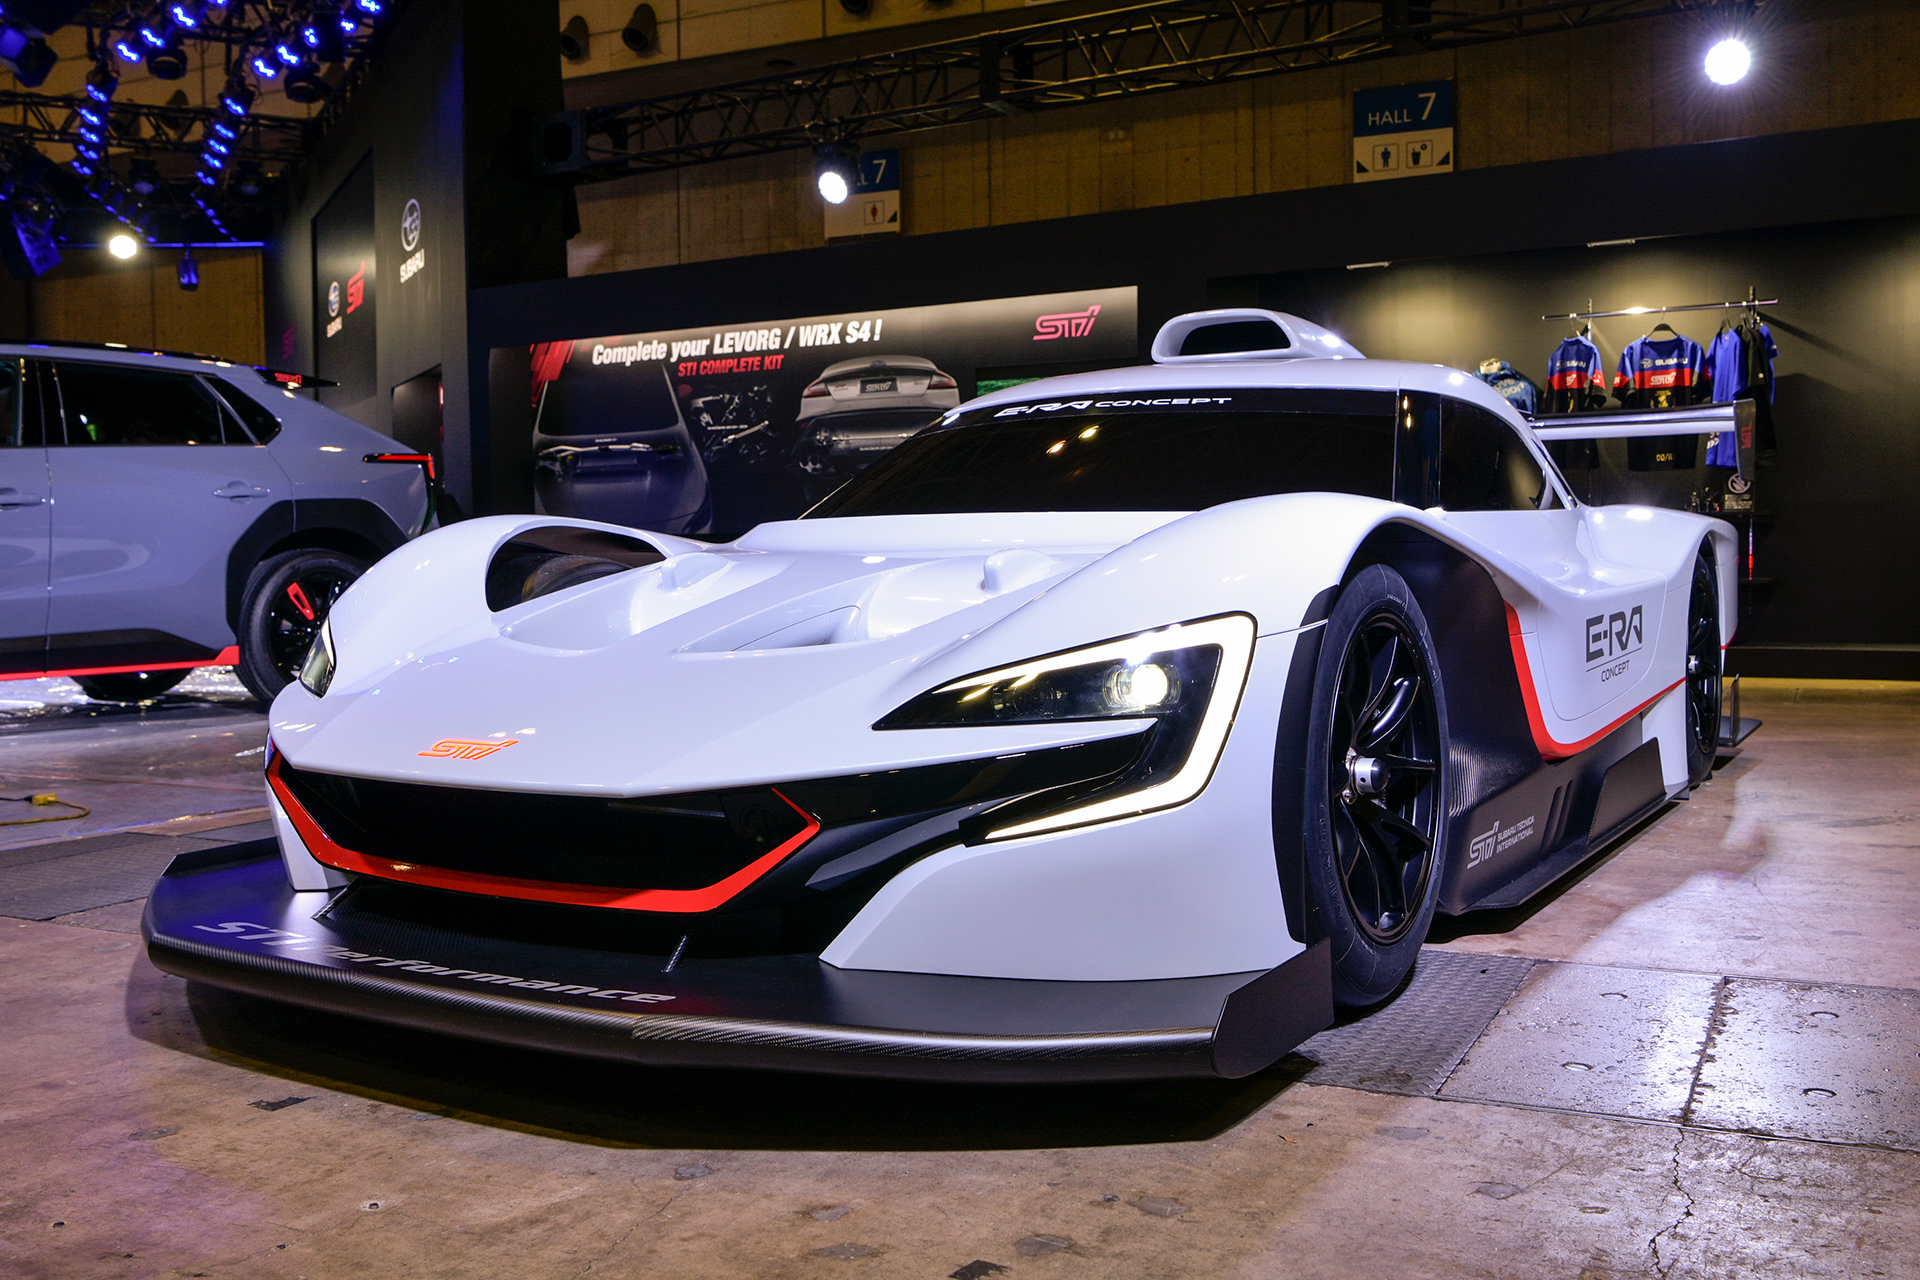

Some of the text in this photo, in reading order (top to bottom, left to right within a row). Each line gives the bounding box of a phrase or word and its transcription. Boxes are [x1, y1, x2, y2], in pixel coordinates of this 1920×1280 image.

[1368, 92, 1436, 126] HALL 7
[872, 159, 886, 184] 7
[592, 340, 668, 367] Complete
[669, 338, 710, 363] your
[713, 328, 782, 355] LEVORG
[799, 322, 843, 347] WRX
[678, 354, 785, 377] STI COMPLETE KIT
[994, 397, 1232, 417] E-RA CONCEPT
[1586, 605, 1642, 663] E-RA
[1601, 660, 1630, 682] CONCEPT
[1496, 827, 1534, 854] INTERNATIONAL
[1497, 815, 1535, 842] SUBARU TECNICA
